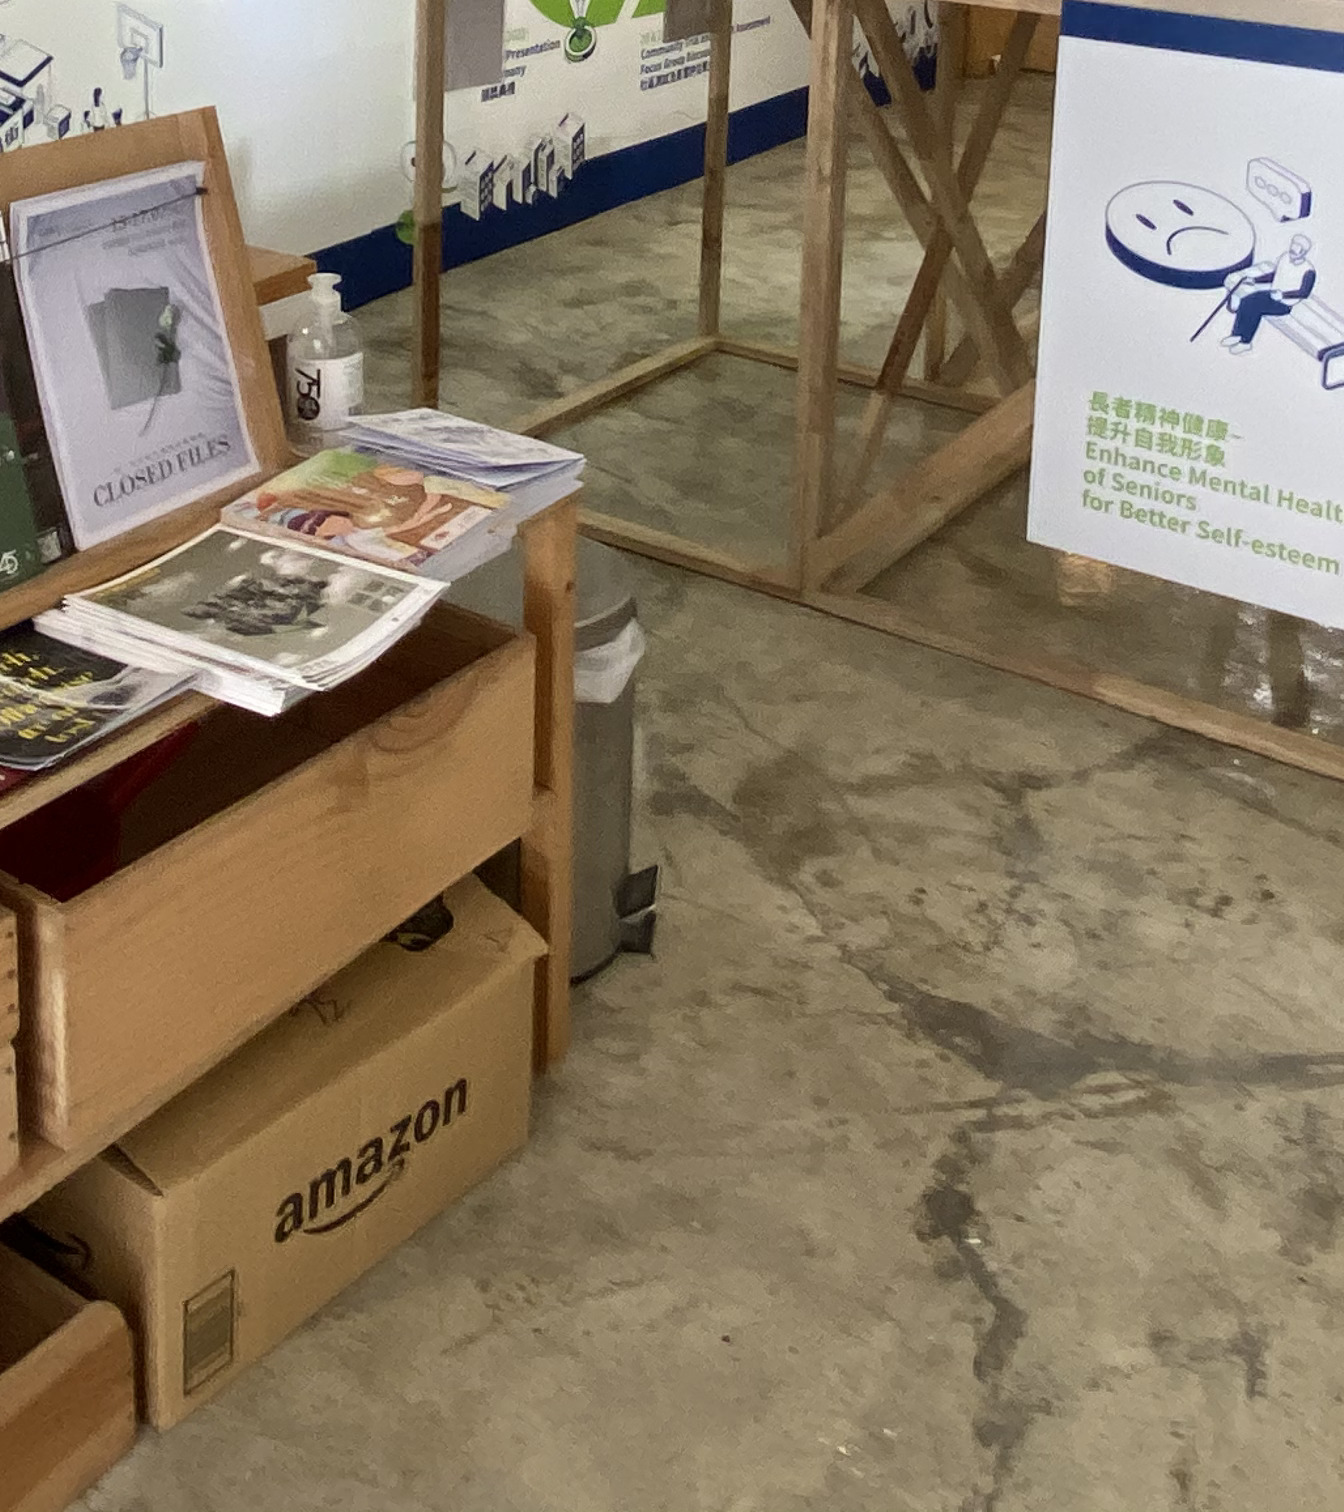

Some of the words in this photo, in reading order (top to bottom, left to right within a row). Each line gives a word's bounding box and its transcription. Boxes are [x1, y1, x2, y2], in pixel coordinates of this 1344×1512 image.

[506, 39, 561, 60] Presentation
[93, 457, 174, 507] CLOSED
[176, 434, 232, 473] FILES
[1085, 441, 1182, 481] Enhance
[1188, 465, 1270, 505] Mental
[1086, 415, 1226, 468] 提升自我形象
[1083, 467, 1106, 487] of
[1111, 471, 1198, 512] Seniors
[1082, 488, 1115, 514] for
[1119, 499, 1192, 536] Better
[1195, 520, 1341, 576] Self-esteem
[274, 1076, 469, 1245] amazon
